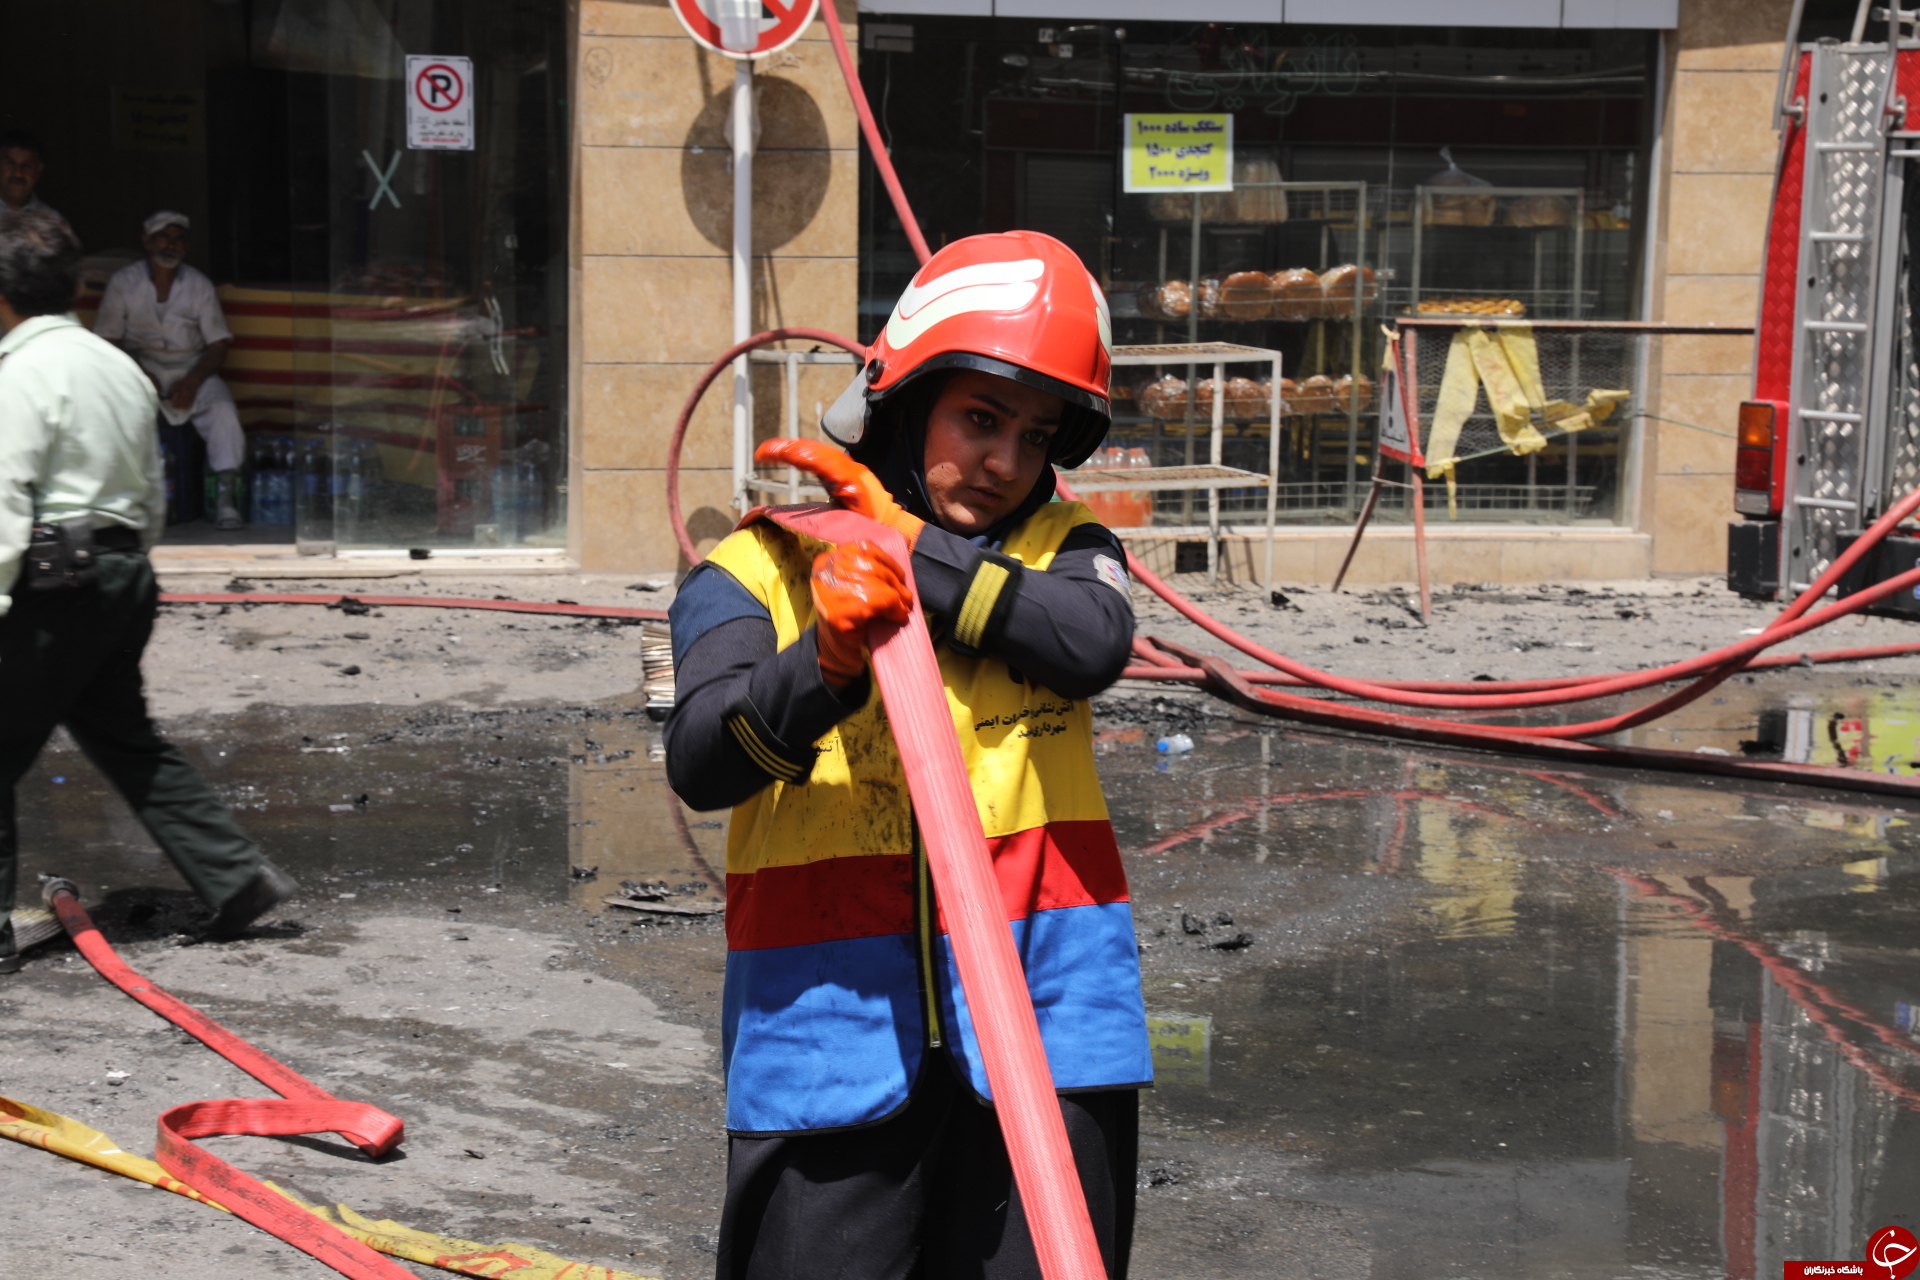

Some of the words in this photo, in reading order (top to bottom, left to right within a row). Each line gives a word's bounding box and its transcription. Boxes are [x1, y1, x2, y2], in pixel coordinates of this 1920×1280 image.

[431, 74, 452, 103] P
[1164, 120, 1190, 133] ساده
[1175, 142, 1214, 158] کنجدی
[974, 715, 999, 731] ایمنی
